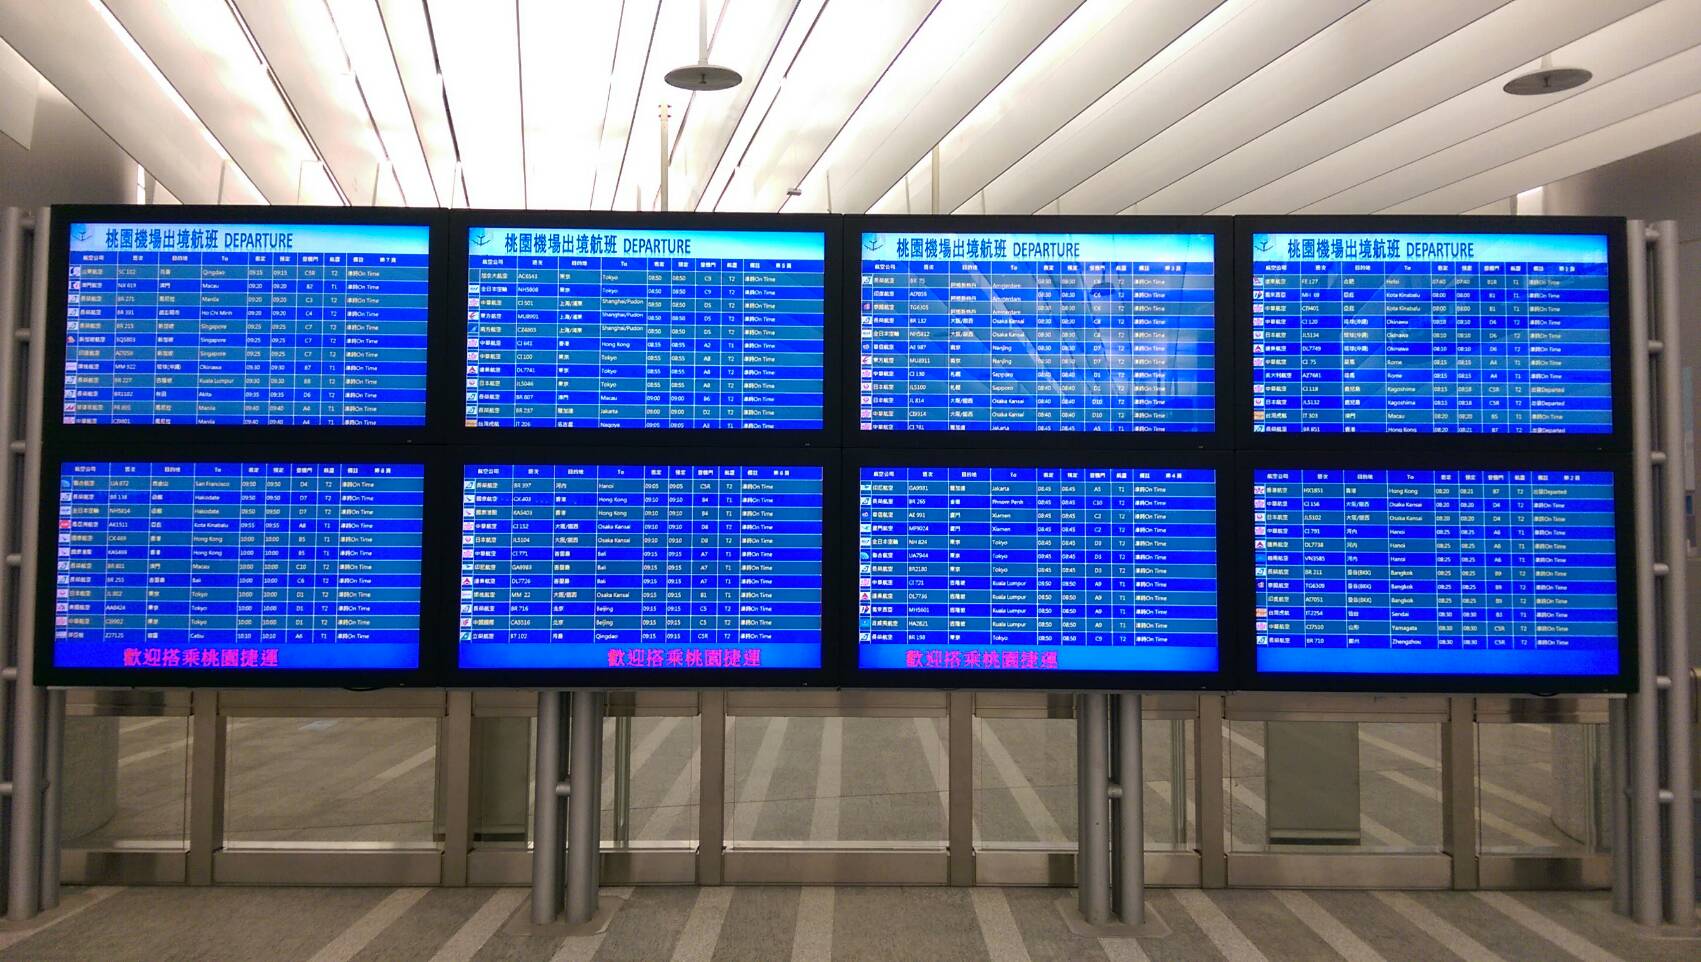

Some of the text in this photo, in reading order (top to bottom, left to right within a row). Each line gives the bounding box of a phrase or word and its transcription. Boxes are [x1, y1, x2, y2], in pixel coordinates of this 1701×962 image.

[106, 228, 218, 249] 桃園機場出境航班
[224, 232, 293, 248] DEPARTURE
[505, 233, 617, 254] 桃園機場出境航班
[624, 238, 691, 254] DEPARTURE
[897, 238, 1006, 259] 桃園機場出境航班
[1013, 242, 1080, 257] DEPARTURE
[1288, 238, 1400, 259] 桃園機場出境航班
[1407, 242, 1474, 258] DEPARTURE
[123, 648, 278, 667] 歡迎搭乘桃園捷運
[608, 648, 761, 667] 歡迎搭乘桃園捷運
[906, 650, 1058, 669] 歡迎搭乘桃園捷運
